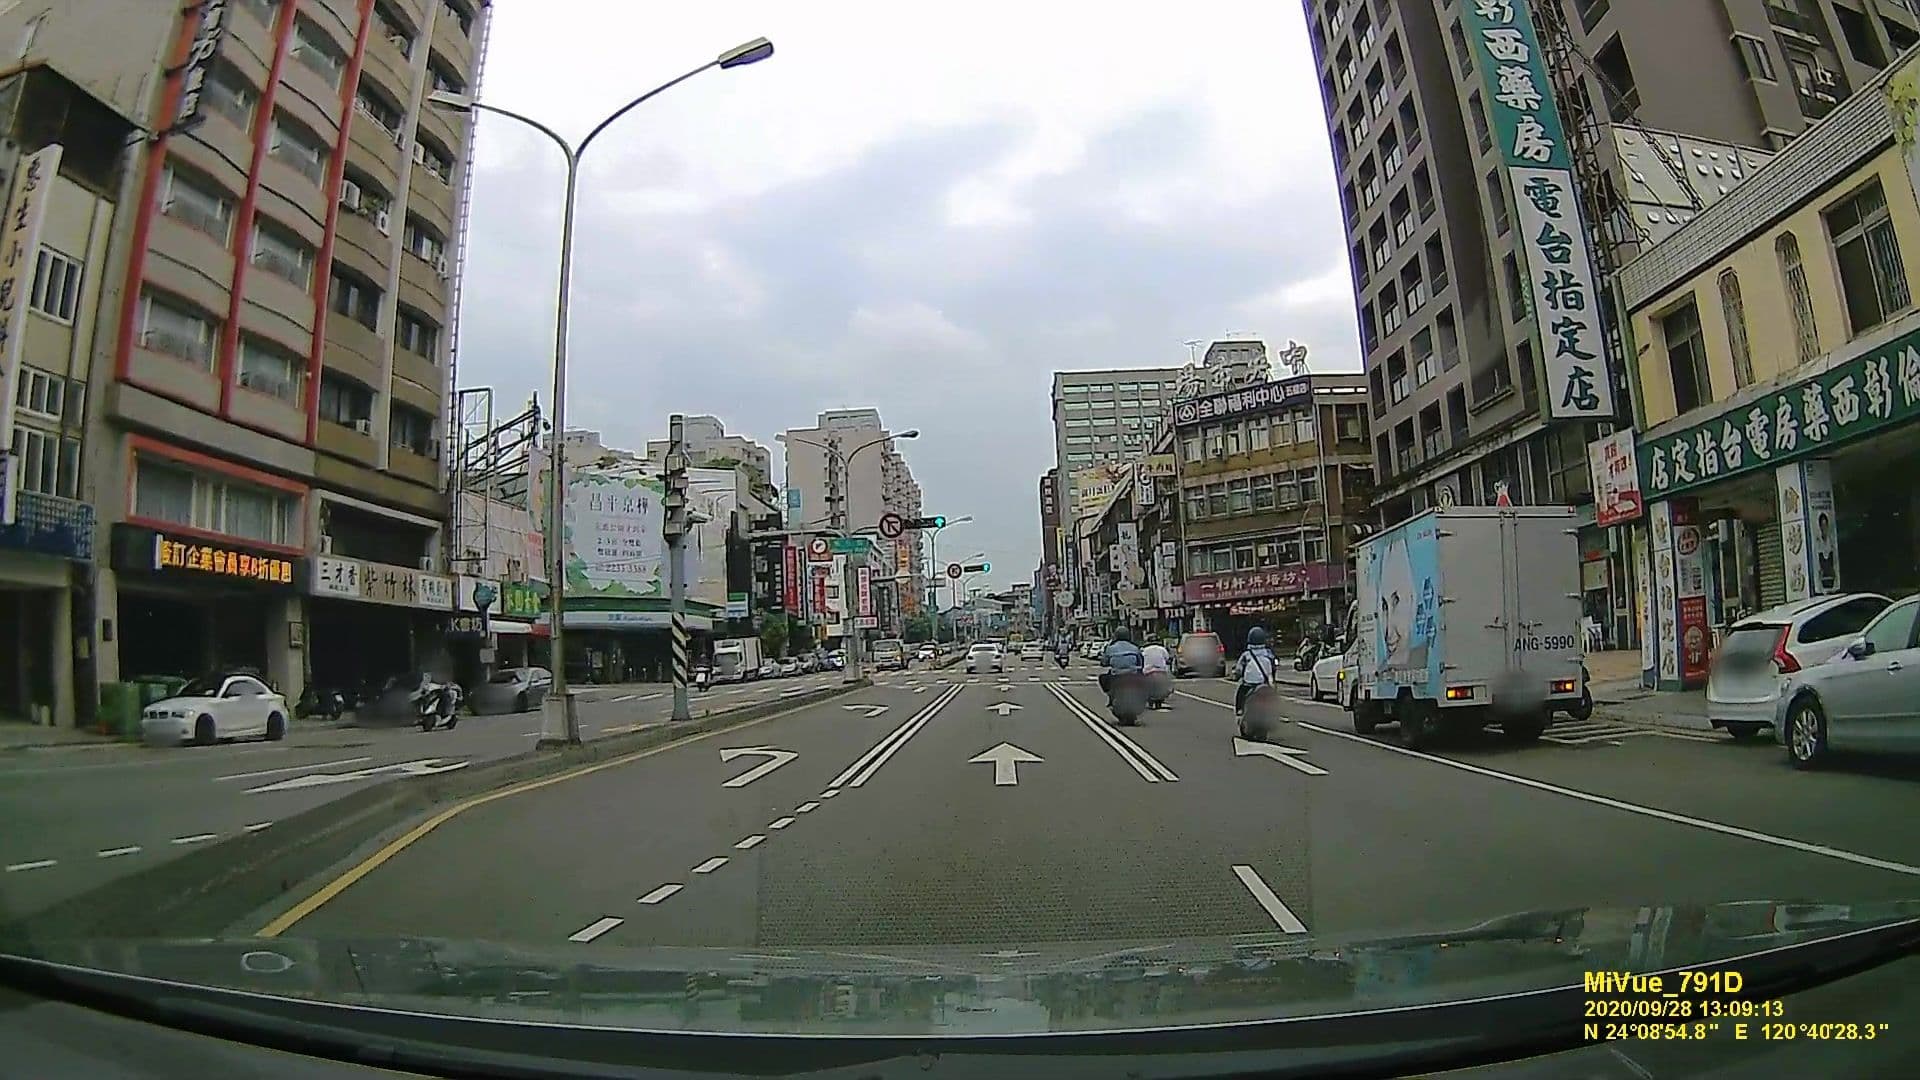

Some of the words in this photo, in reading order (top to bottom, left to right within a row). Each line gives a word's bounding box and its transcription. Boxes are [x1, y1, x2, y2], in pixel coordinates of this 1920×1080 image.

[1523, 177, 1600, 411] 電台指定店
[1199, 384, 1285, 419] 全聯福利中心
[1514, 634, 1576, 652] ANG-5990
